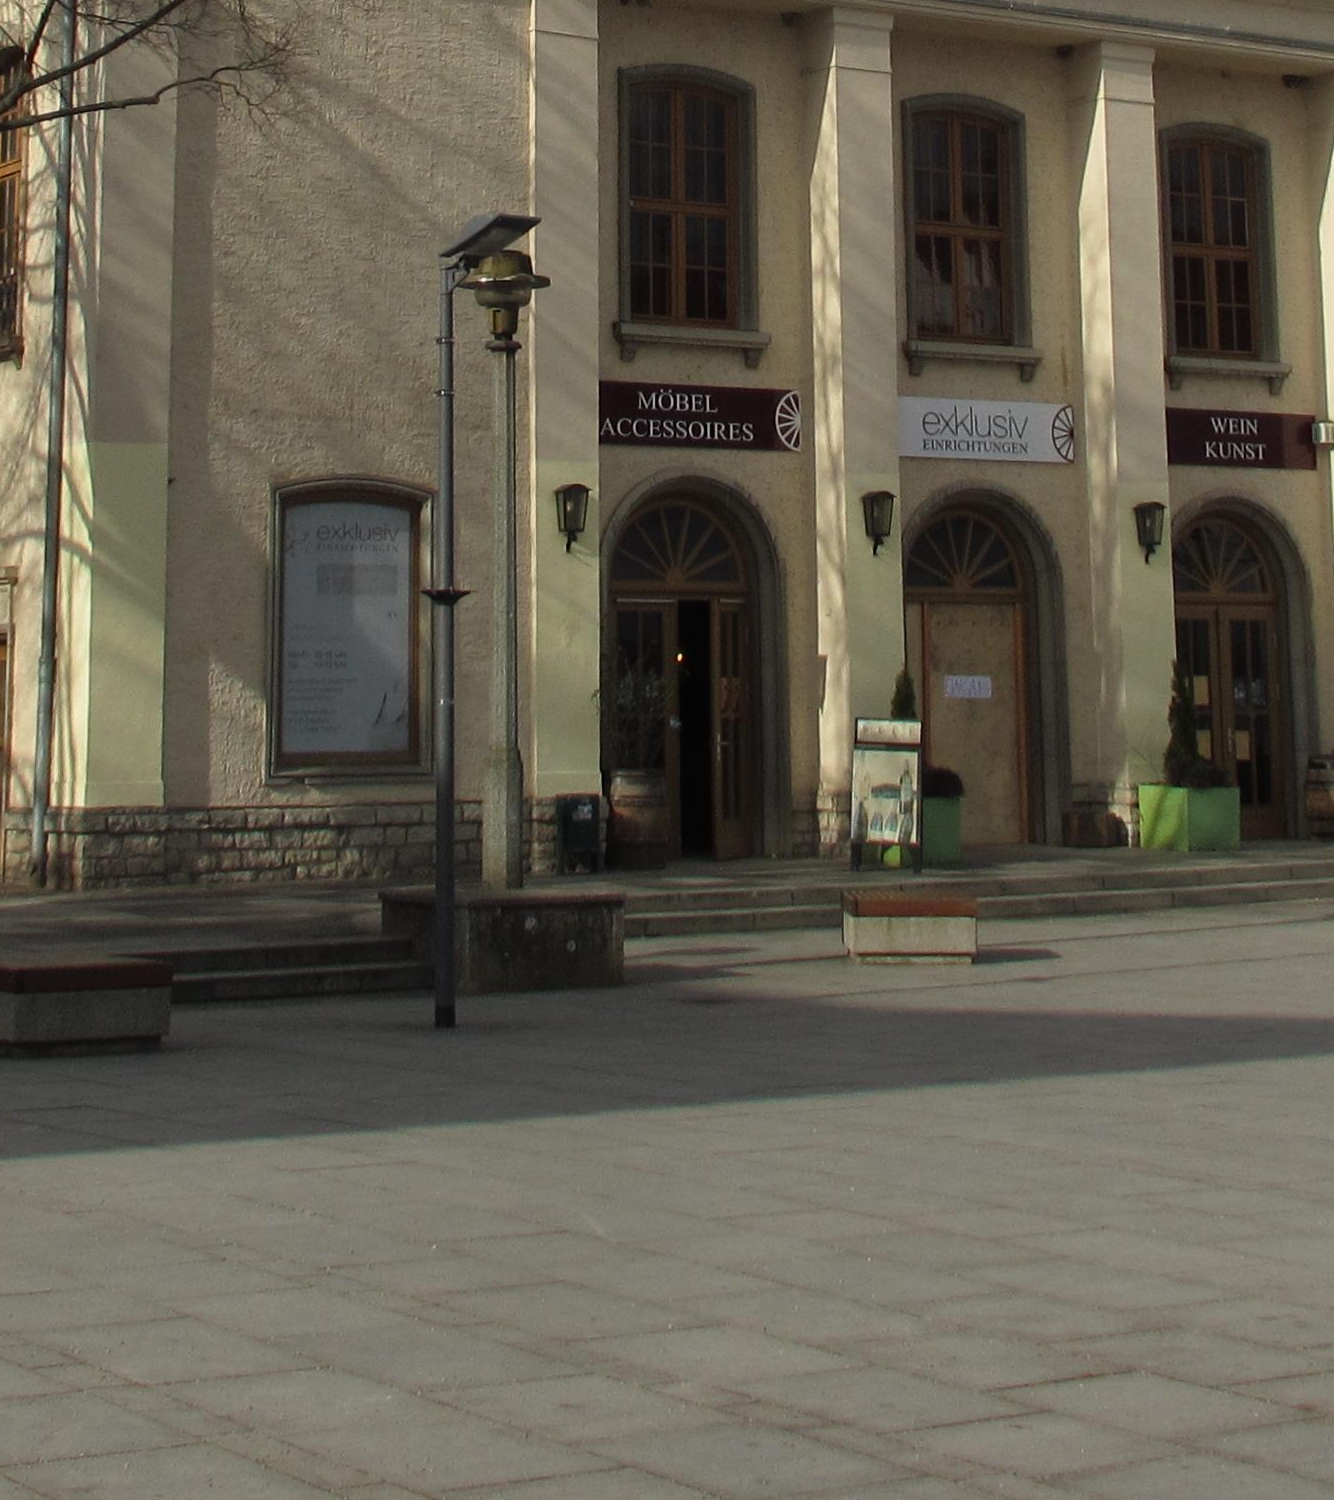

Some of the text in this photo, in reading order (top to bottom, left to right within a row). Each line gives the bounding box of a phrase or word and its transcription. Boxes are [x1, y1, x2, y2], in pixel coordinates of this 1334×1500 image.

[637, 388, 718, 413] MÖBEL
[600, 417, 754, 442] ACCESSOIRES
[922, 405, 1028, 439] exklusiv
[1210, 417, 1258, 435] WEIN
[923, 438, 1028, 454] EINRICHTUNGEN
[1205, 441, 1266, 460] KUNST
[316, 521, 400, 542] exklusiv
